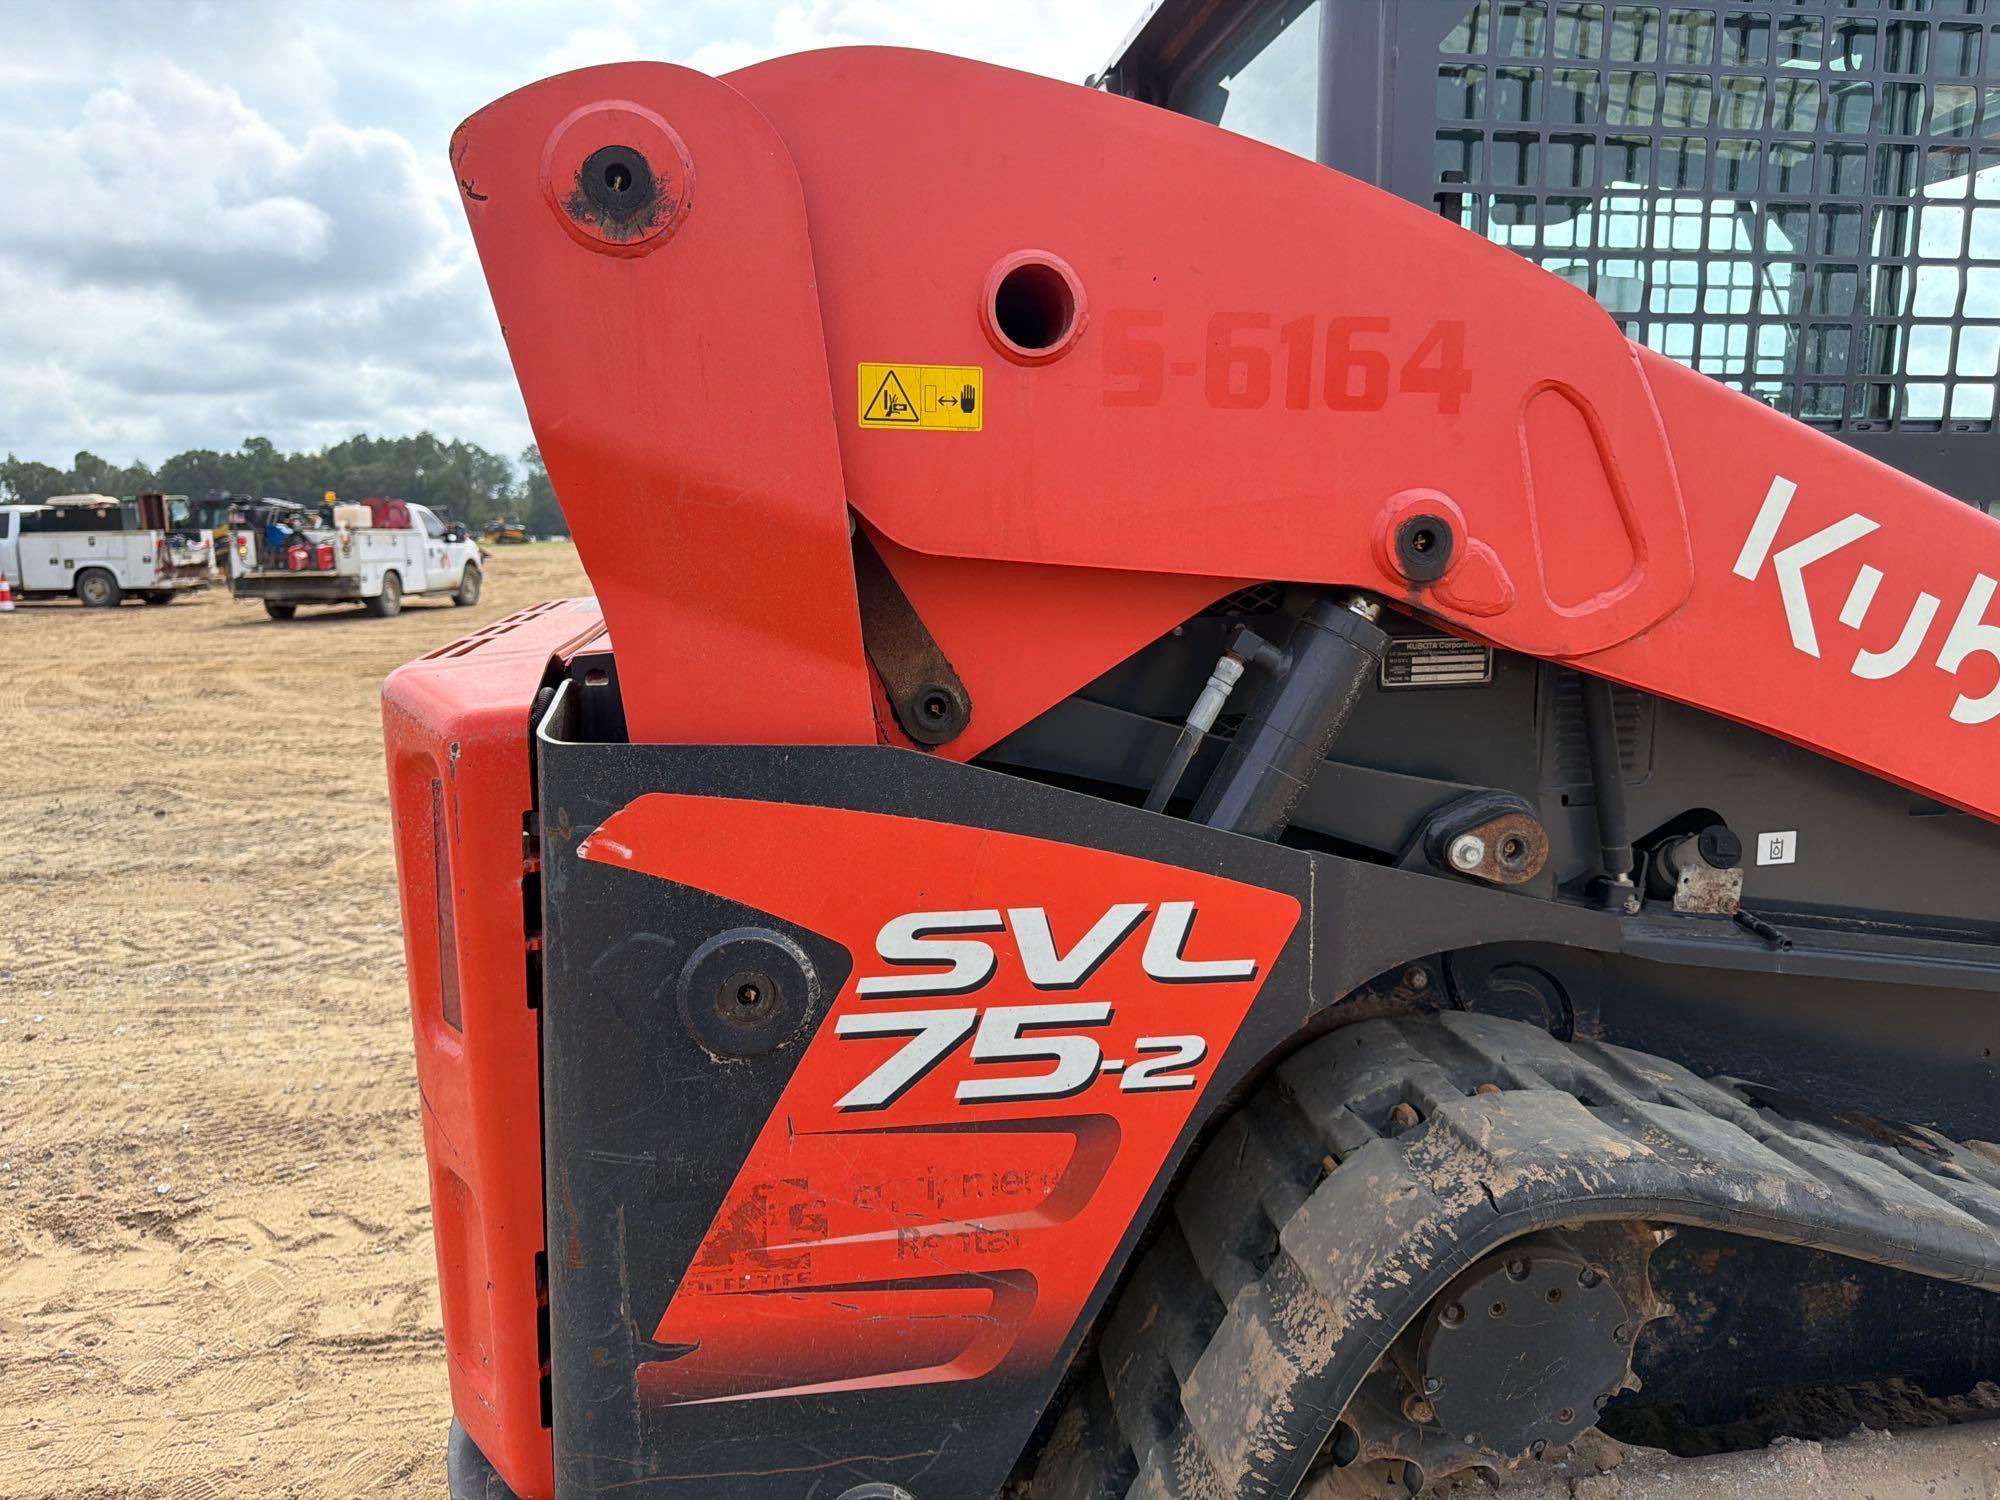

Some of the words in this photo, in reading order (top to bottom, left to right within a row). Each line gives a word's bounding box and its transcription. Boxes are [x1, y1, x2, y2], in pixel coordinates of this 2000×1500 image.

[1102, 309, 1473, 414] S-6164
[1406, 641, 1438, 651] KUBOTA
[855, 900, 1258, 1000] SVL
[832, 1001, 1209, 1113] 75-2
